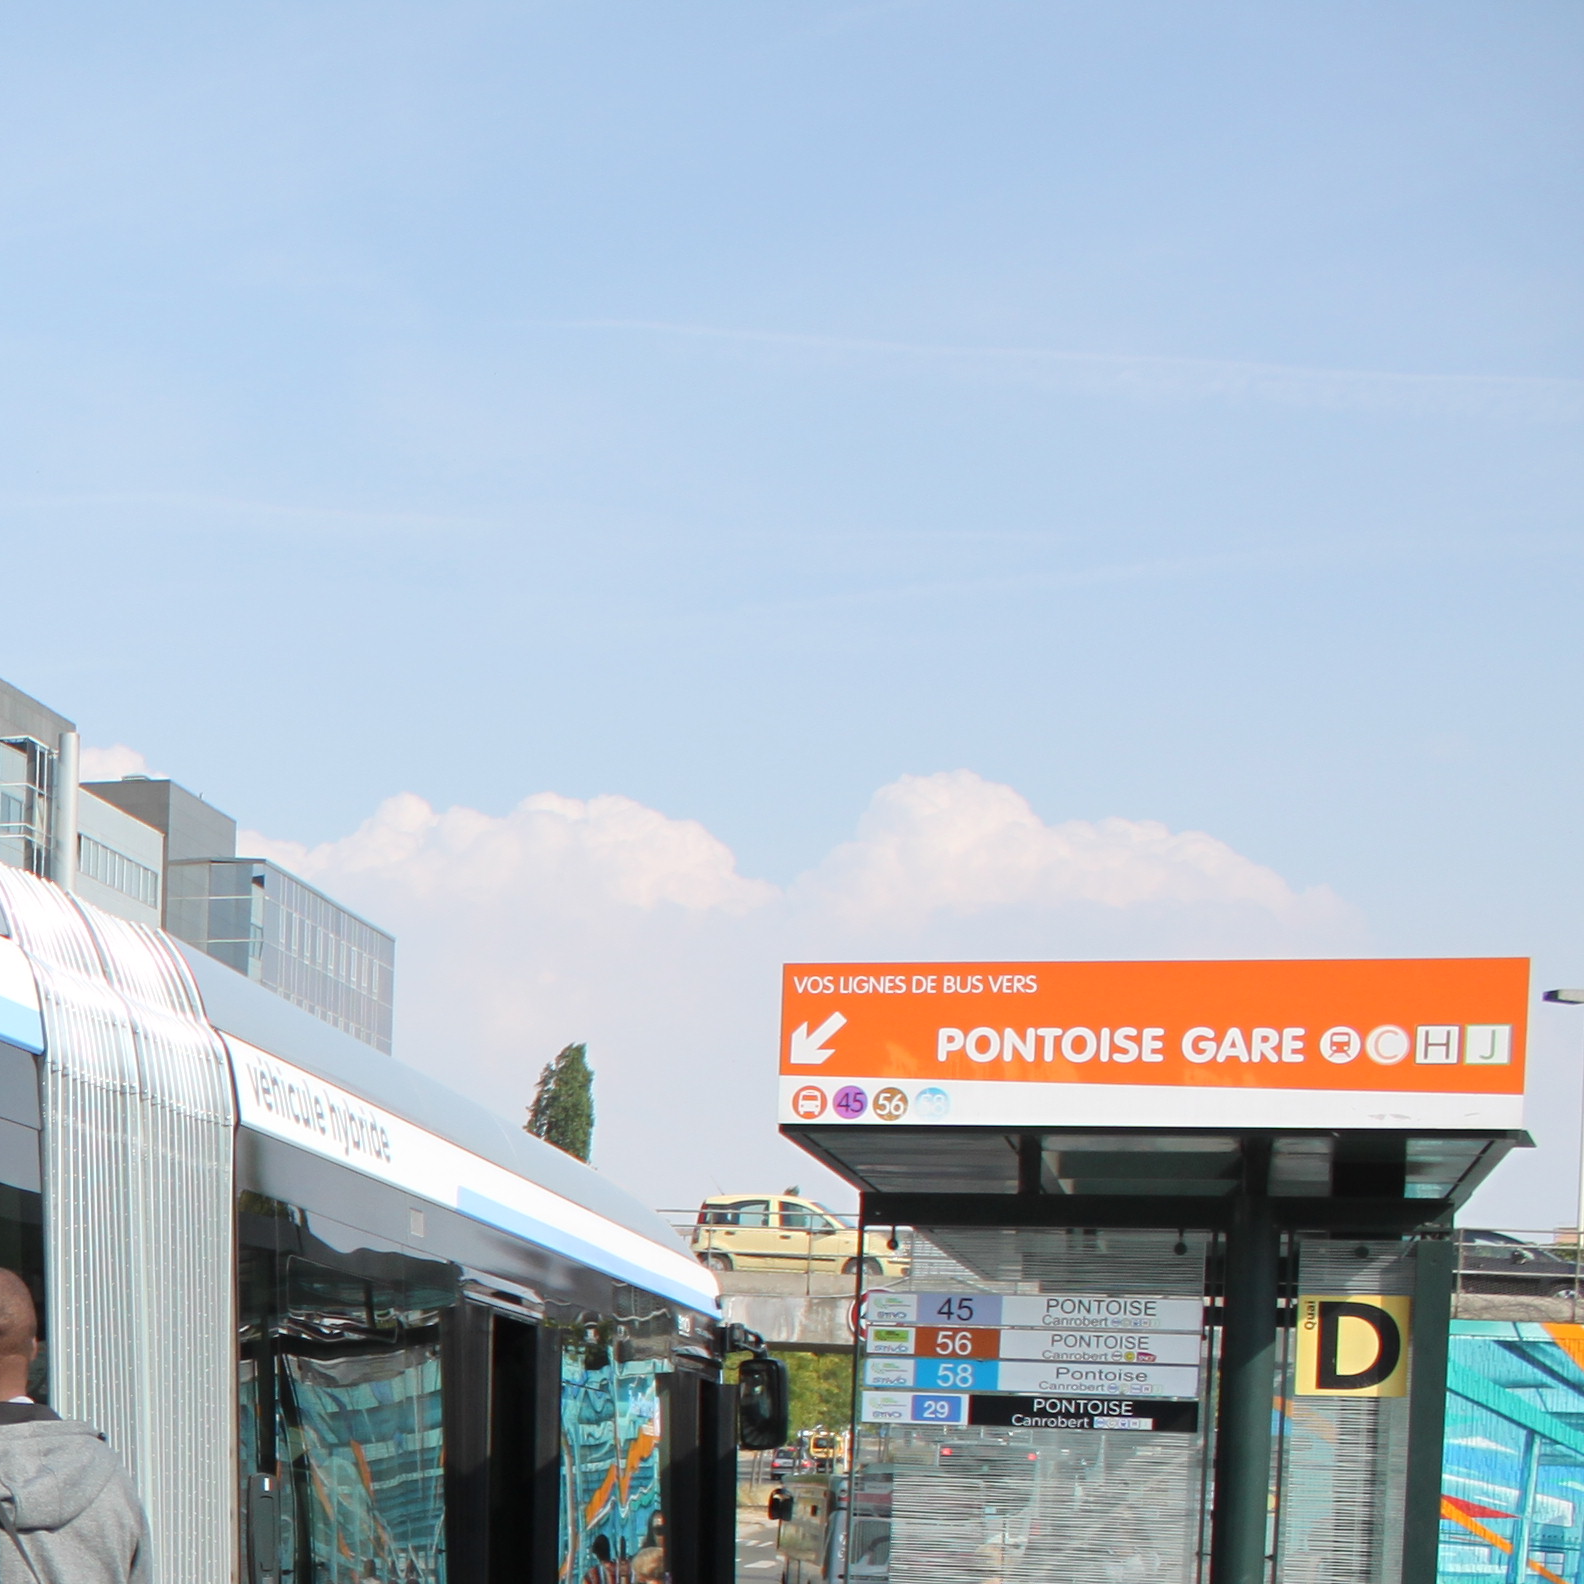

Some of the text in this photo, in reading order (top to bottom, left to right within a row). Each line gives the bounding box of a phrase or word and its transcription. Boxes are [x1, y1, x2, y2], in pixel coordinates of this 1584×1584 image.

[793, 974, 1038, 994] VOS LIGNES DE BUS VERS
[936, 1026, 1166, 1064] PONTOISE
[1180, 1026, 1306, 1064] GARE
[1423, 1029, 1452, 1060] H
[836, 1092, 865, 1114] 45
[876, 1093, 905, 1116] 56
[322, 1088, 392, 1164] hybride
[937, 1297, 974, 1321] 45
[1045, 1298, 1158, 1317] PONTOISE
[1041, 1314, 1109, 1327] Canrobert
[935, 1331, 1150, 1356] 56 PONTOISE
[1041, 1349, 1109, 1361] Canrobert
[1316, 1300, 1401, 1390] D
[936, 1363, 1148, 1388] 58 Pontoise
[1038, 1380, 1105, 1392] Canrobert
[922, 1400, 950, 1419] 29
[1033, 1398, 1134, 1416] PONTOISE
[1011, 1413, 1089, 1429] Canrobert
